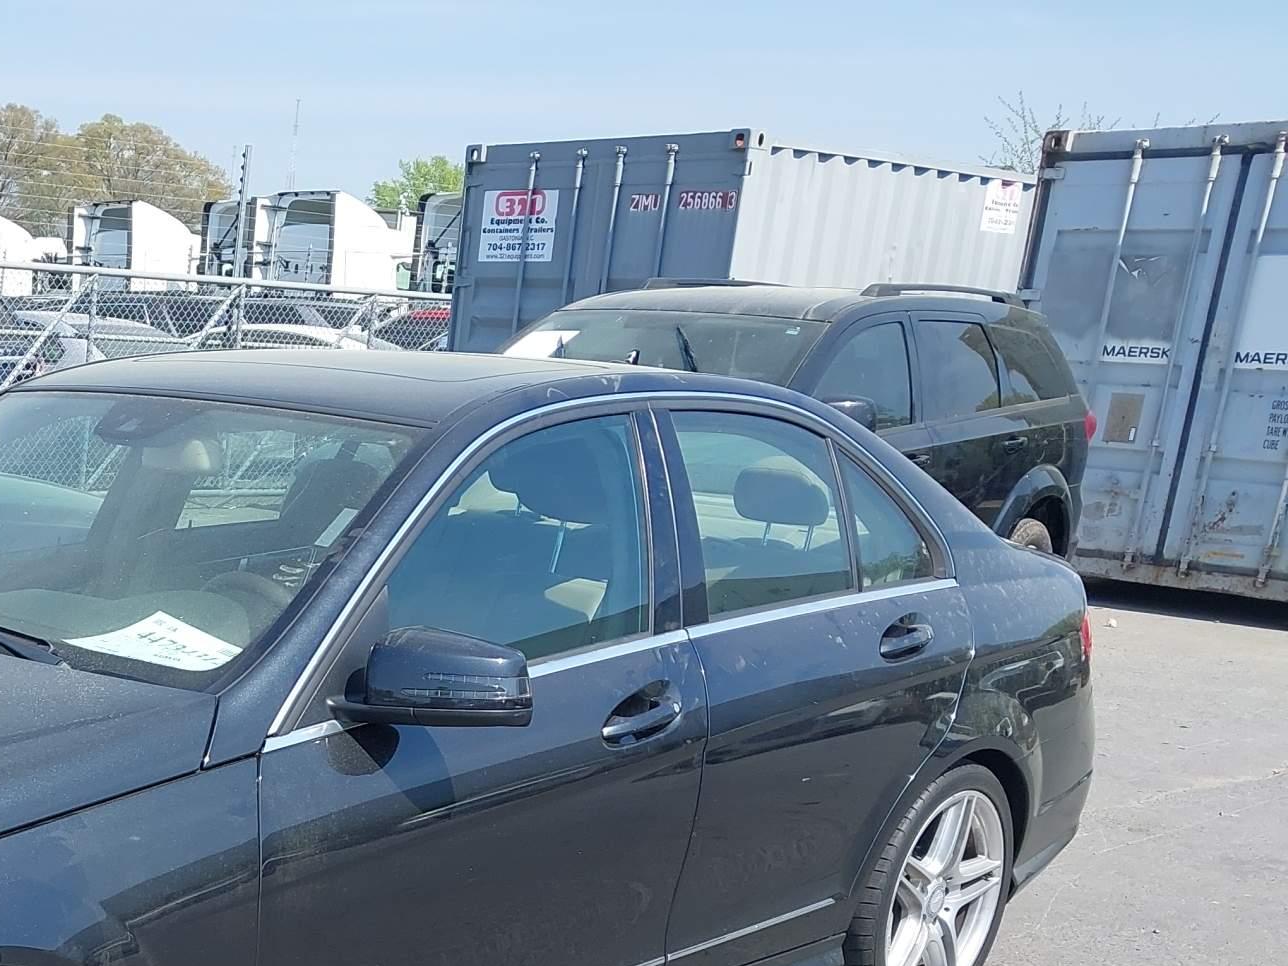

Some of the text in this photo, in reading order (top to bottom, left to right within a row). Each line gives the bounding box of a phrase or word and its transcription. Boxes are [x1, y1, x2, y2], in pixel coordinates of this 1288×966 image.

[630, 194, 661, 212] ZIMU
[679, 192, 723, 210] 256866
[490, 216, 548, 226] Equipmet Co.
[487, 243, 546, 251] 704-8672317
[1102, 344, 1171, 359] MAERSK
[1234, 351, 1288, 365] MAER
[1263, 439, 1280, 450] CUBE
